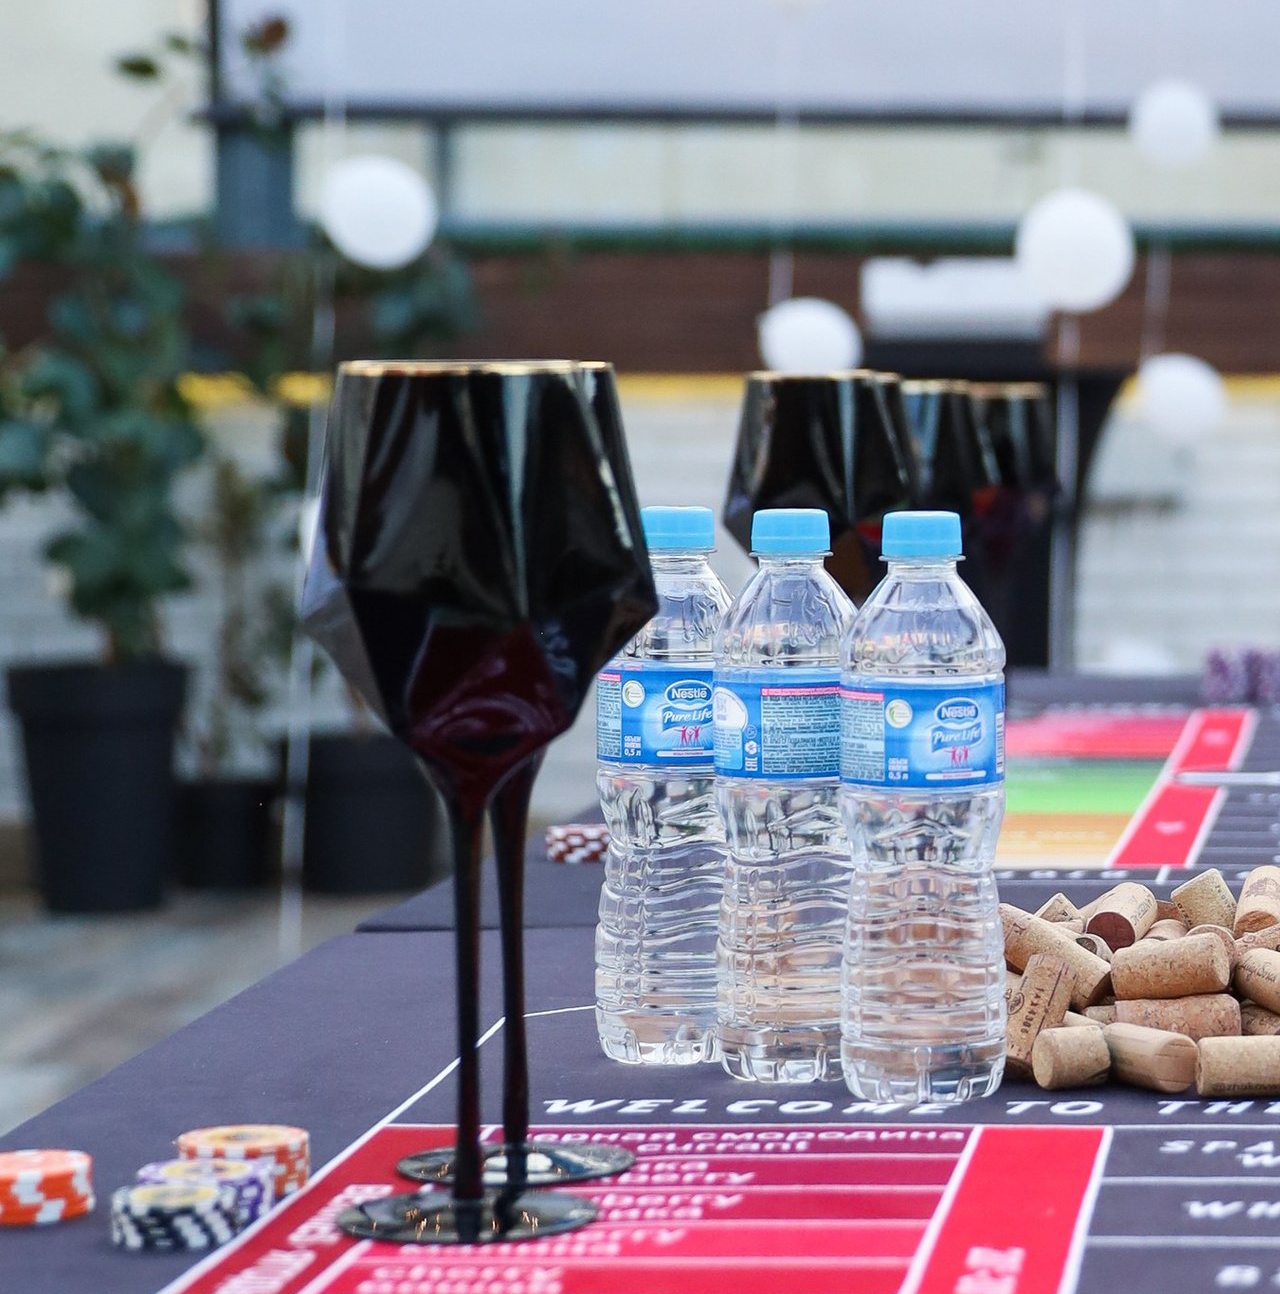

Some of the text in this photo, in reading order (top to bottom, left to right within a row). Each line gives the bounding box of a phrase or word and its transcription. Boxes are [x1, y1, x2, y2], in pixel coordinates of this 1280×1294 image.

[671, 687, 708, 699] Nestlé
[663, 707, 713, 724] Pure Life
[543, 1098, 962, 1115] WELCOME
[1006, 1100, 1104, 1116] TO
